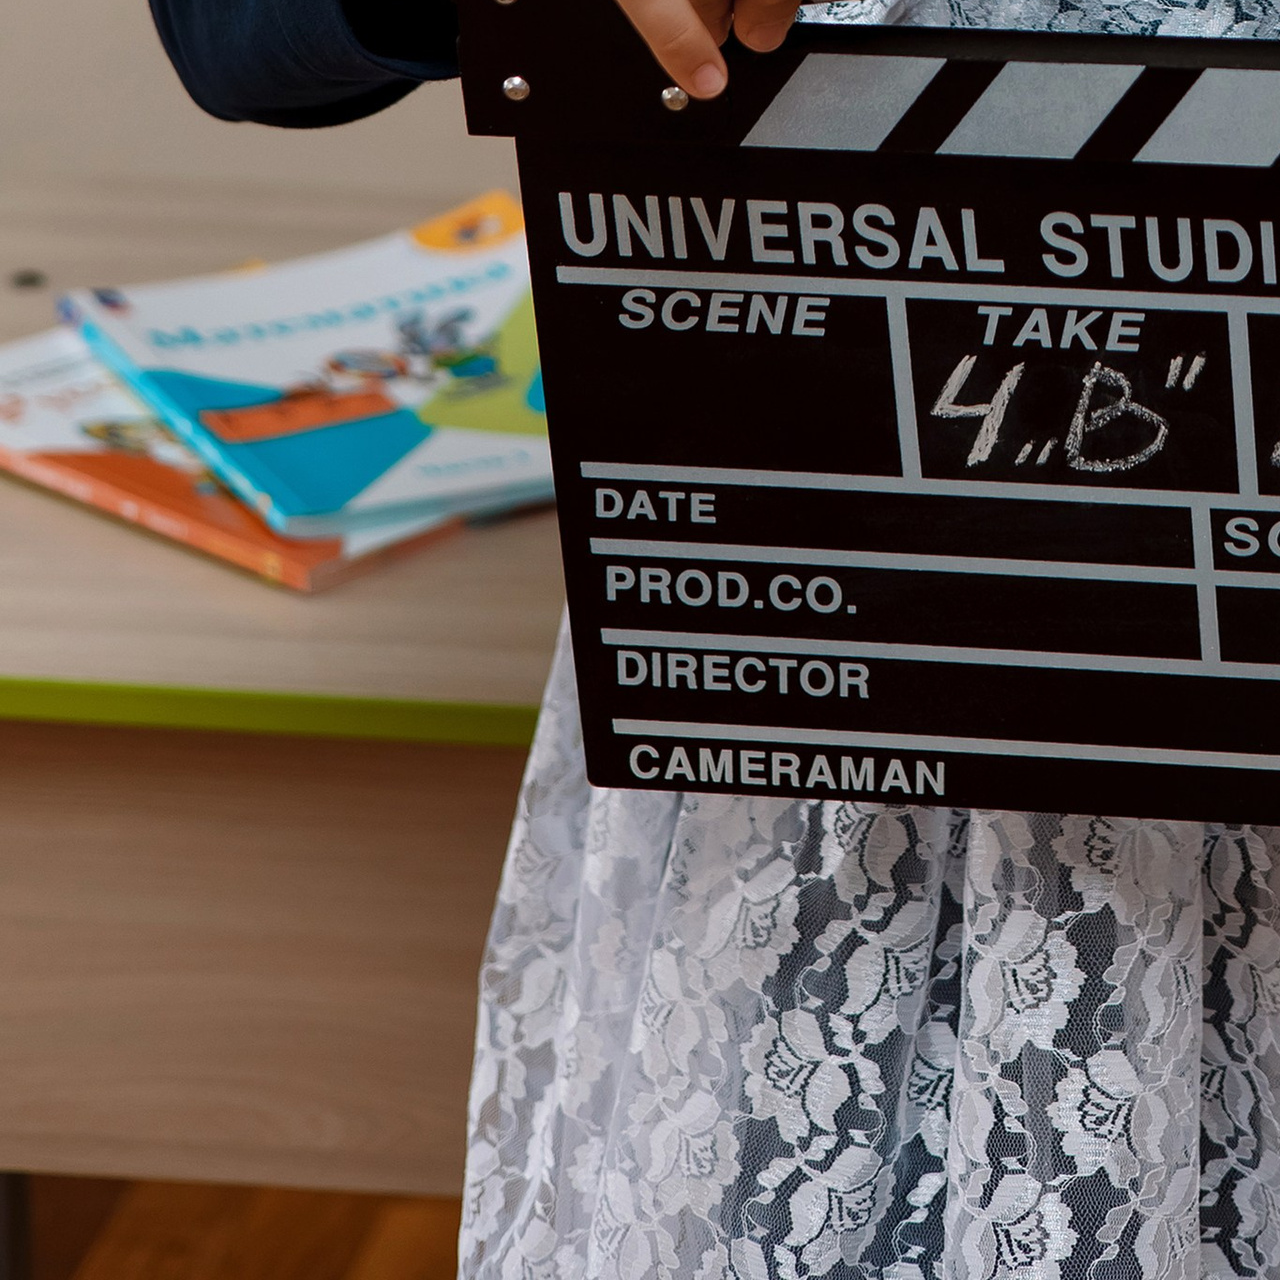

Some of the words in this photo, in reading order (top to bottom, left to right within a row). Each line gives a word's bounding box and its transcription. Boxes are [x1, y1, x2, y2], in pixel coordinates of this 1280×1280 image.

[557, 192, 1006, 274] UNIVERSAL
[618, 288, 831, 337] SCENE
[975, 305, 1146, 353] TAKE
[595, 488, 717, 524] DATE
[605, 565, 858, 614] PROD.CO.
[616, 650, 870, 699] DIRECTOR
[628, 744, 946, 796] CAMERAMAN
